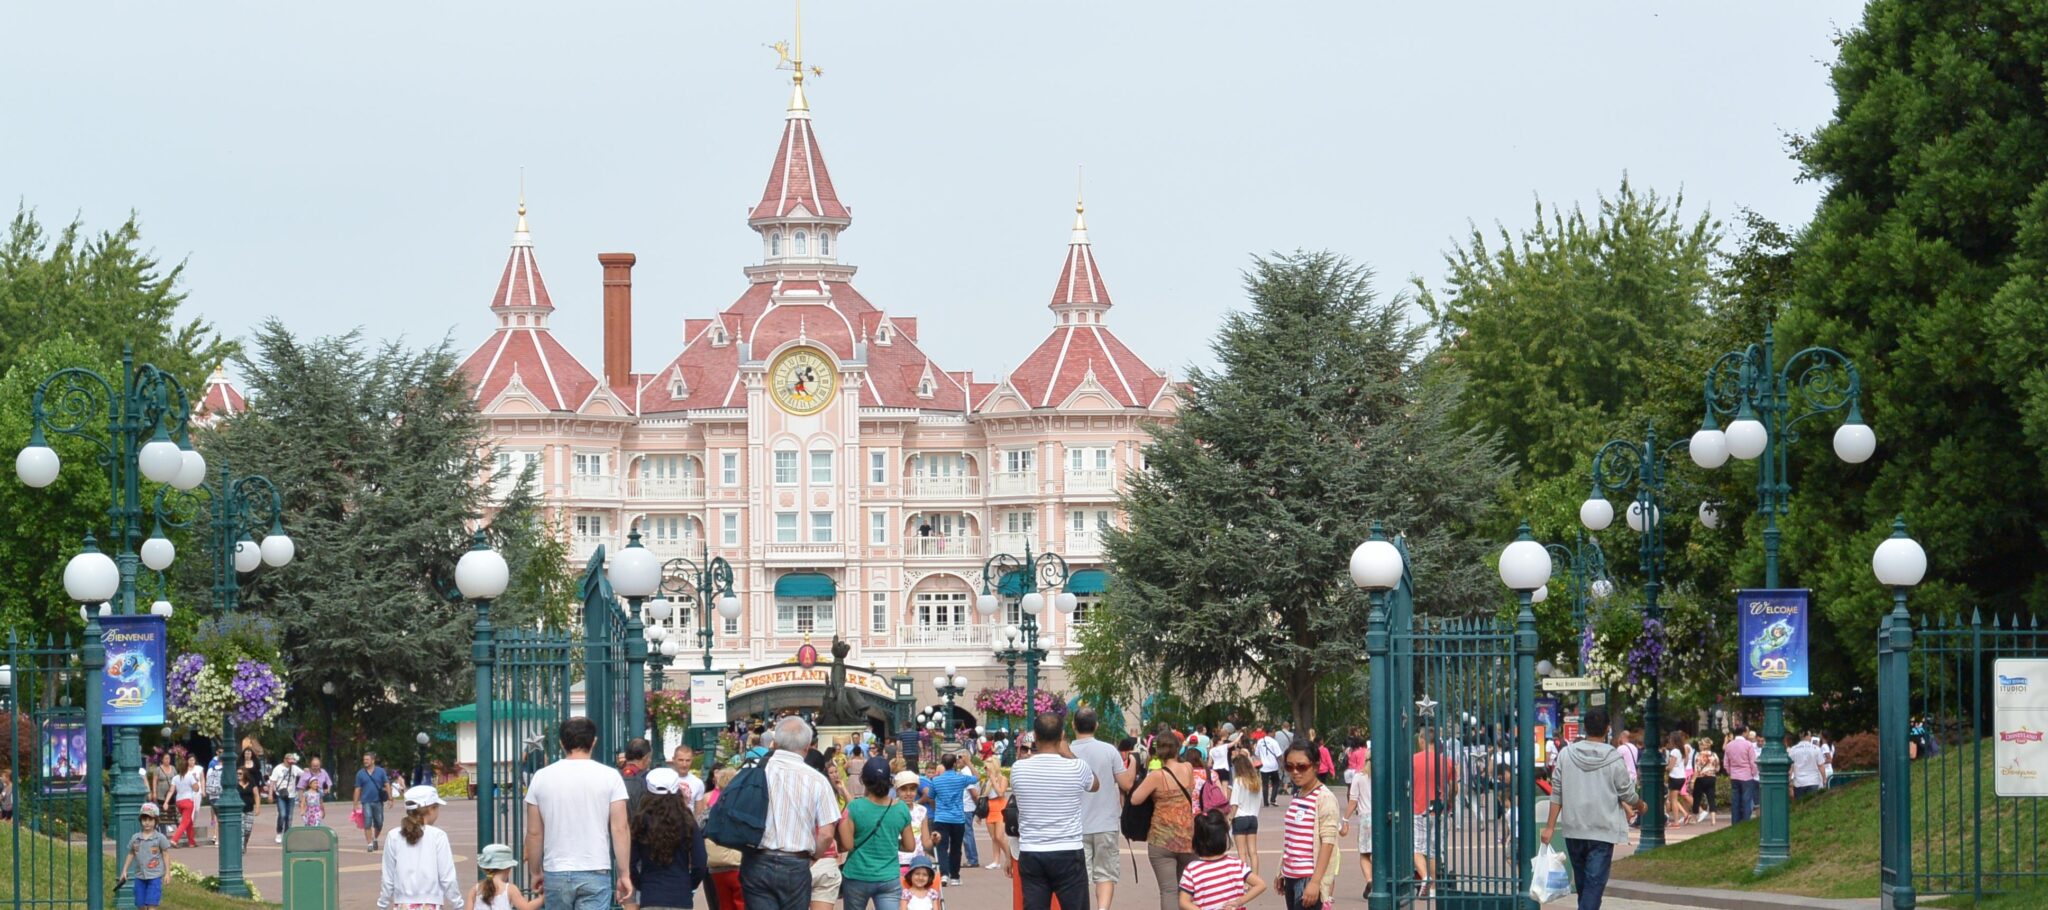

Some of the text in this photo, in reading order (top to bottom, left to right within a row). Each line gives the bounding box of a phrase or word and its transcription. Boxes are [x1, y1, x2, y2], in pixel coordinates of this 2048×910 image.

[1749, 601, 1799, 615] WELCOME
[101, 628, 155, 643] BIENVENUE
[1761, 658, 1788, 676] 20
[744, 669, 828, 689] DISNEYLAND
[115, 687, 142, 705] 20
